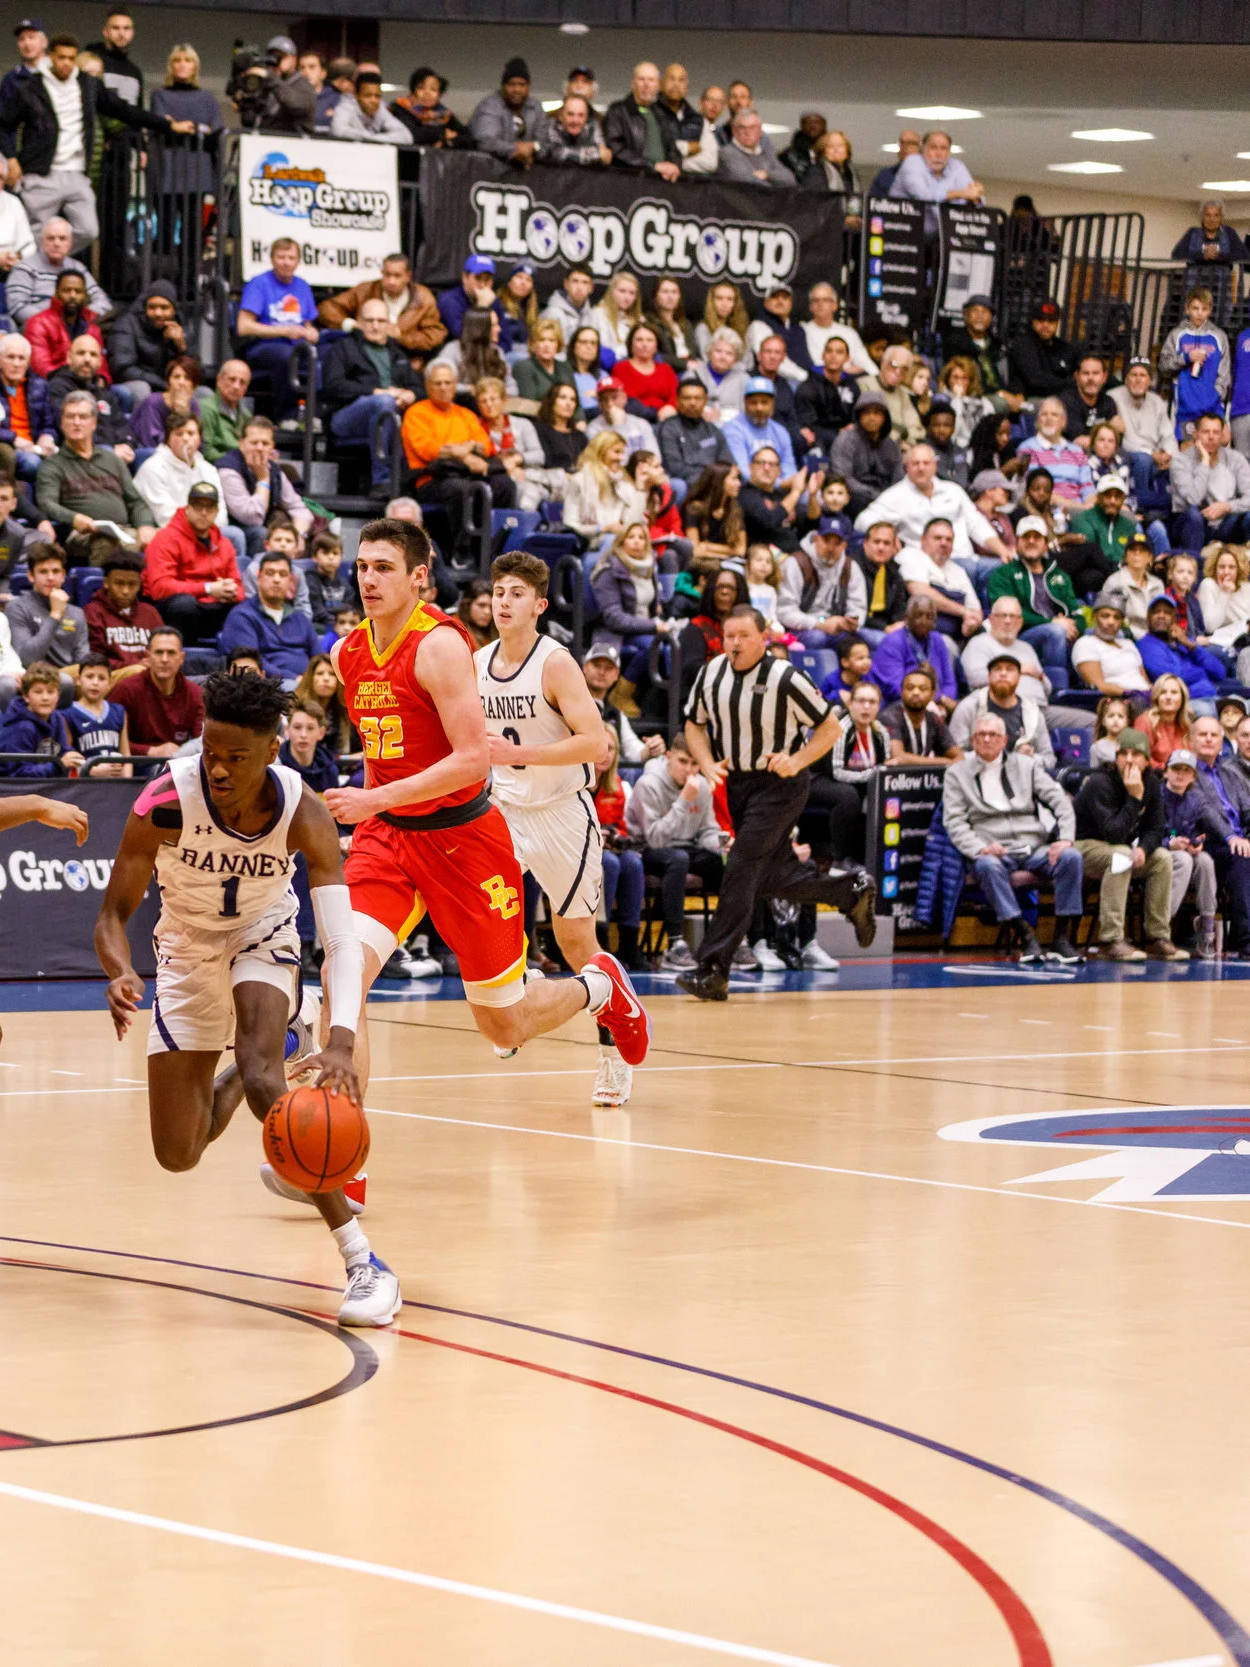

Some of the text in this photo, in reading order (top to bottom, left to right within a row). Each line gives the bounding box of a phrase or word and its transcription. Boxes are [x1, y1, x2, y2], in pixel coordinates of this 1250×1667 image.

[311, 209, 386, 231] Showcase
[106, 626, 151, 646] FORDHA
[353, 695, 400, 710] CATHOLIC
[359, 714, 405, 760] 32
[883, 774, 922, 791] Follow
[180, 847, 290, 877] RANNEY
[218, 875, 241, 918] 1
